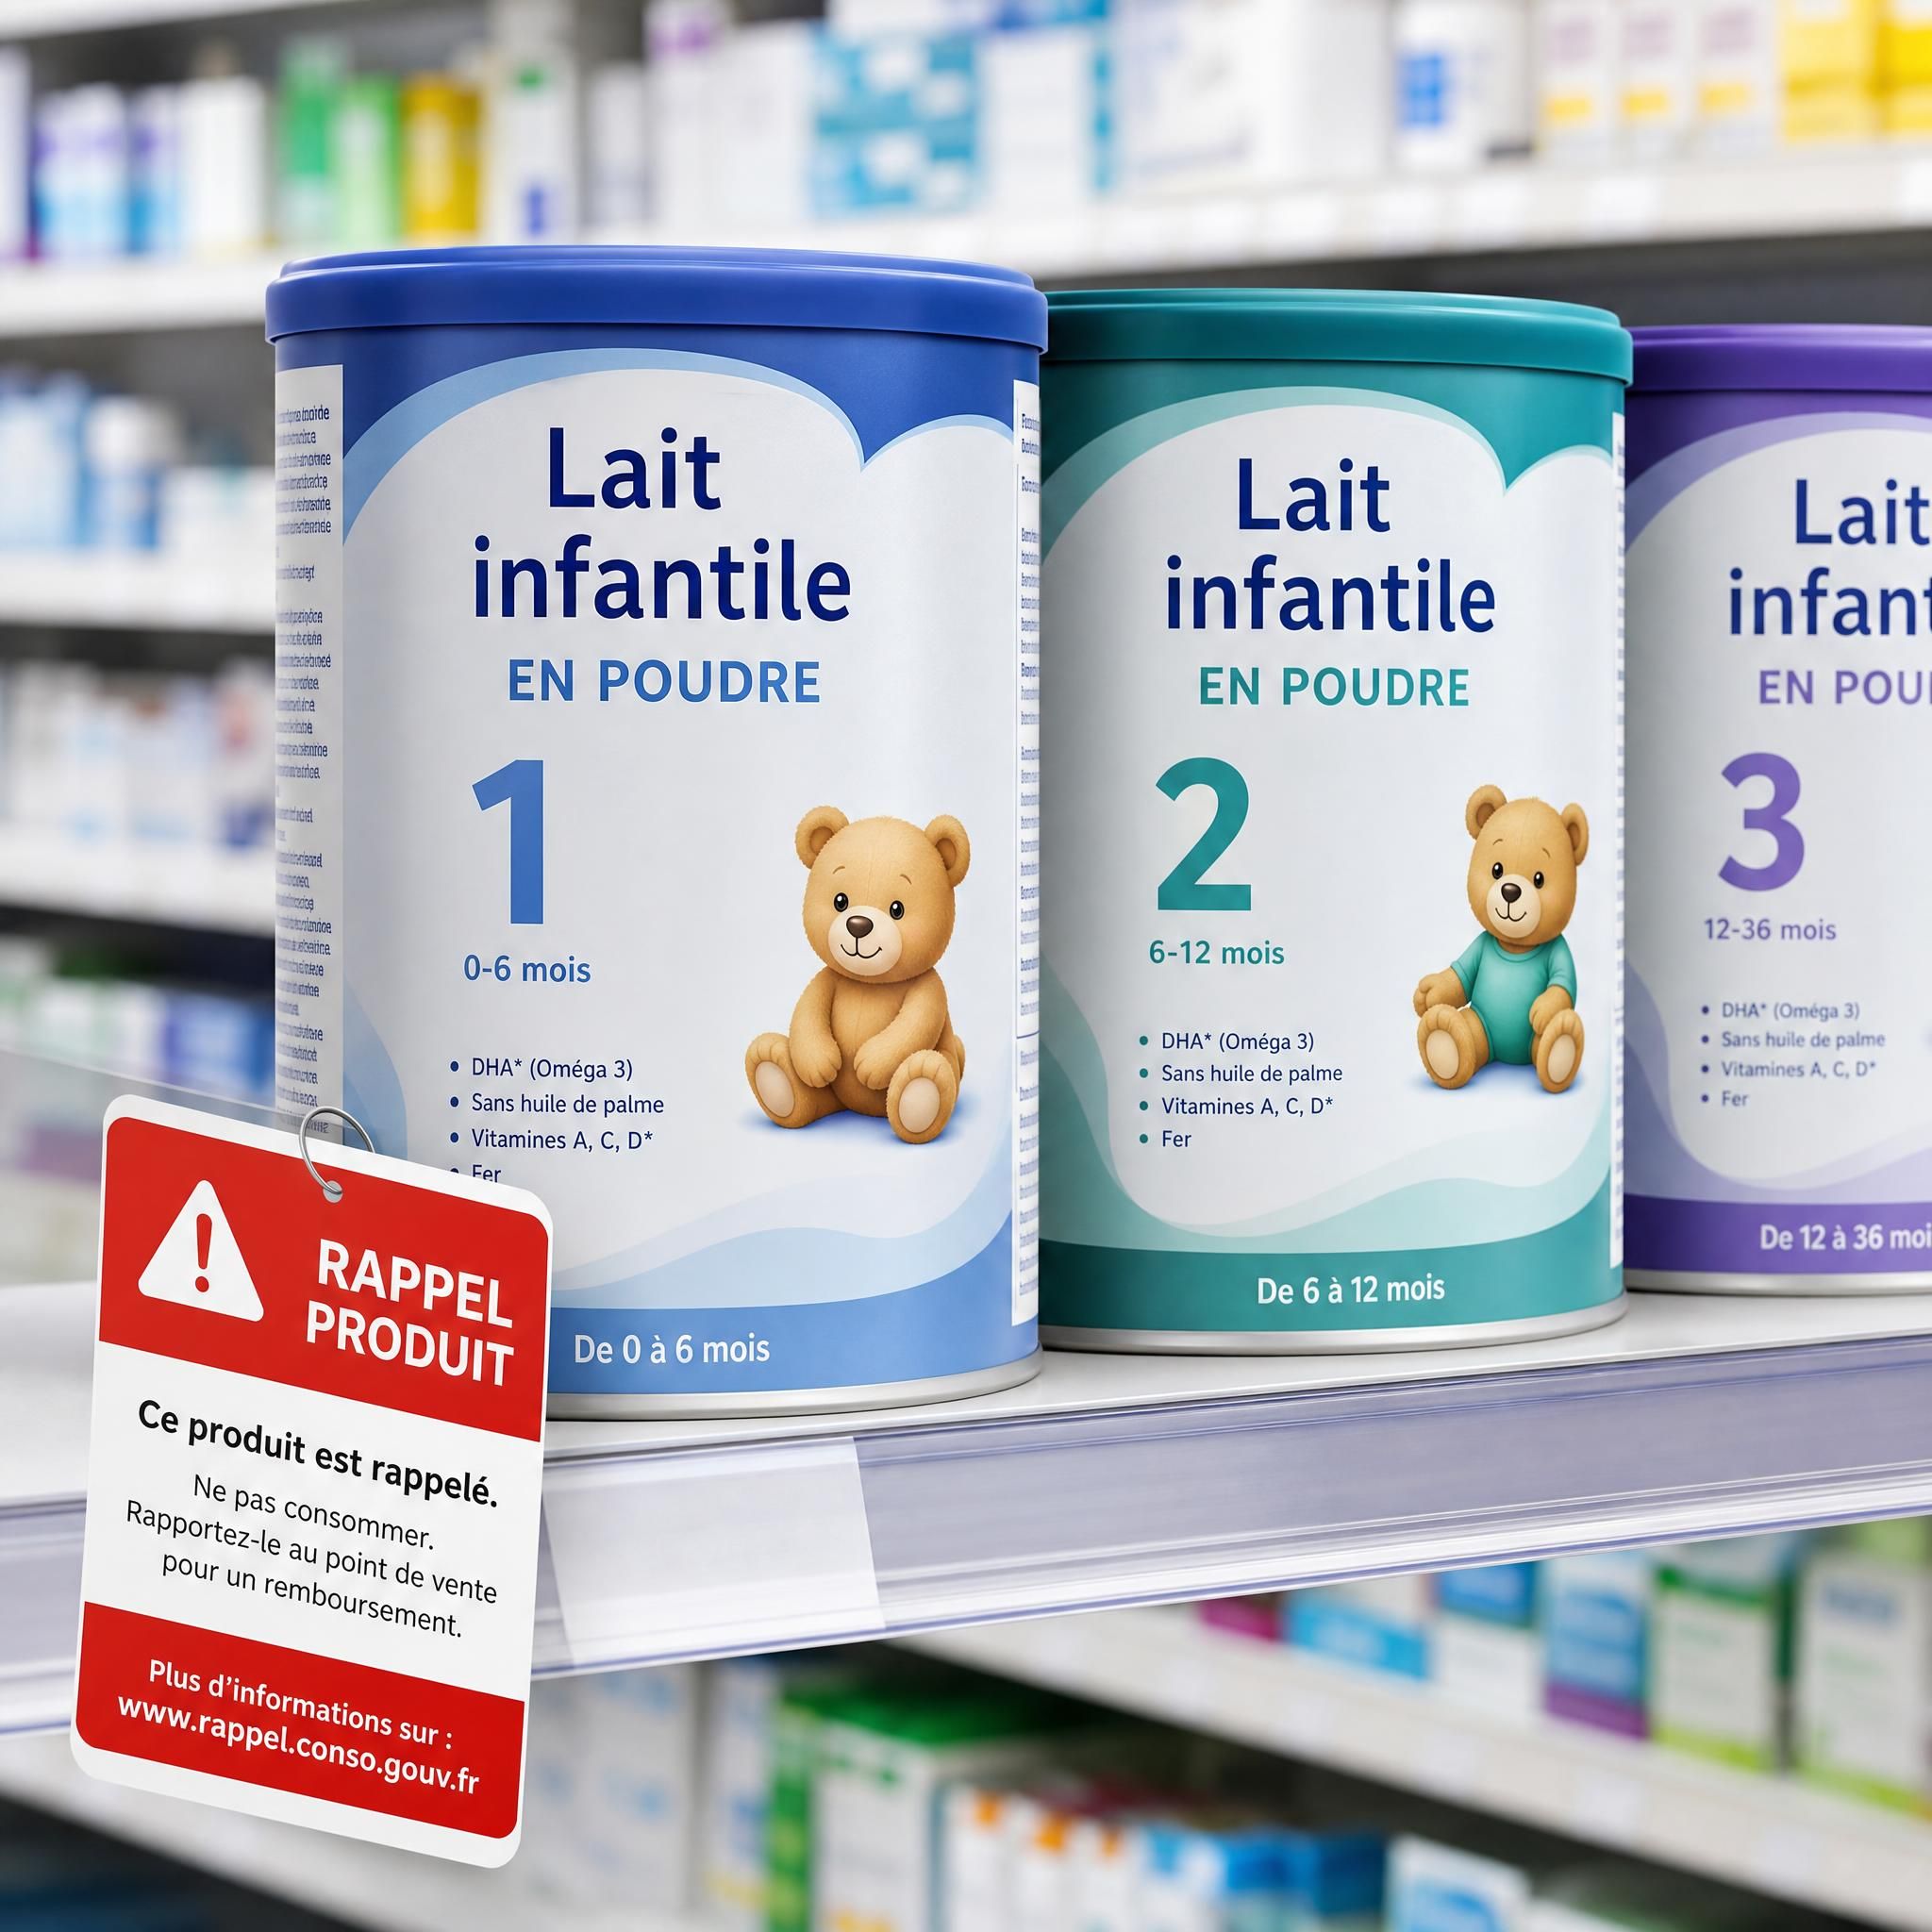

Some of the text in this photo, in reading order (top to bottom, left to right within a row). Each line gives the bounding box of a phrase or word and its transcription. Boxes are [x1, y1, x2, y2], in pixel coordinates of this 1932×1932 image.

[549, 426, 722, 510] Lait
[1239, 458, 1391, 533] Lait
[1795, 478, 1930, 546] Lait
[475, 533, 851, 623] infantile
[1167, 554, 1495, 633] infantile
[509, 658, 820, 703] EN POUDRE
[1200, 666, 1469, 707] EN POUDRE
[1759, 669, 1813, 705] EN
[1155, 757, 1252, 911] 2
[1717, 752, 1805, 892] 3
[472, 758, 544, 925] 1
[1704, 917, 1837, 941] 12-36 mois
[463, 954, 591, 983] 0-6 mois
[1149, 940, 1285, 965] 6-12 mois
[1773, 1002, 1839, 1023] (Oméga
[1843, 1002, 1860, 1021] 3)
[1219, 1032, 1291, 1055] (Oméga
[1297, 1031, 1314, 1053] 3)
[1721, 1030, 1886, 1051] Sans huile de palme
[530, 1058, 608, 1083] (Oméga
[613, 1058, 633, 1082] 3)
[1161, 1064, 1343, 1086] Sans huile de palme
[1720, 1060, 1805, 1077] Vitamines
[1809, 1061, 1827, 1078] A,
[1832, 1060, 1850, 1080] C,
[472, 1092, 664, 1119] Sans huile de palme
[1161, 1096, 1255, 1115] Vitamines
[1260, 1097, 1279, 1118] A,
[1286, 1097, 1304, 1118] C,
[1722, 1090, 1748, 1108] Fer
[471, 1128, 567, 1149] Vitamines
[573, 1130, 592, 1153] A,
[600, 1130, 620, 1153] C,
[1162, 1129, 1192, 1148] Fer
[472, 1163, 502, 1183] Fer
[1760, 1224, 1793, 1251] De
[1799, 1224, 1826, 1250] 12
[1832, 1224, 1846, 1250] à
[1853, 1224, 1884, 1250] 36
[318, 1238, 513, 1329] RAPPEL
[1257, 1273, 1445, 1305] De 6 à 12 mois
[307, 1300, 515, 1386] PRODUIT
[575, 1332, 771, 1364] De 0 à 6 mois
[138, 1399, 497, 1508] Ce produit est rappelé.
[193, 1474, 434, 1551] Ne pas consommer.
[126, 1499, 497, 1604] Rapportez-le au point de vente
[162, 1554, 461, 1638] pour un remboursement.
[149, 1658, 452, 1750] Plus d’informations sur :
[118, 1696, 480, 1794] www.rappel.conso.gouv.fr
